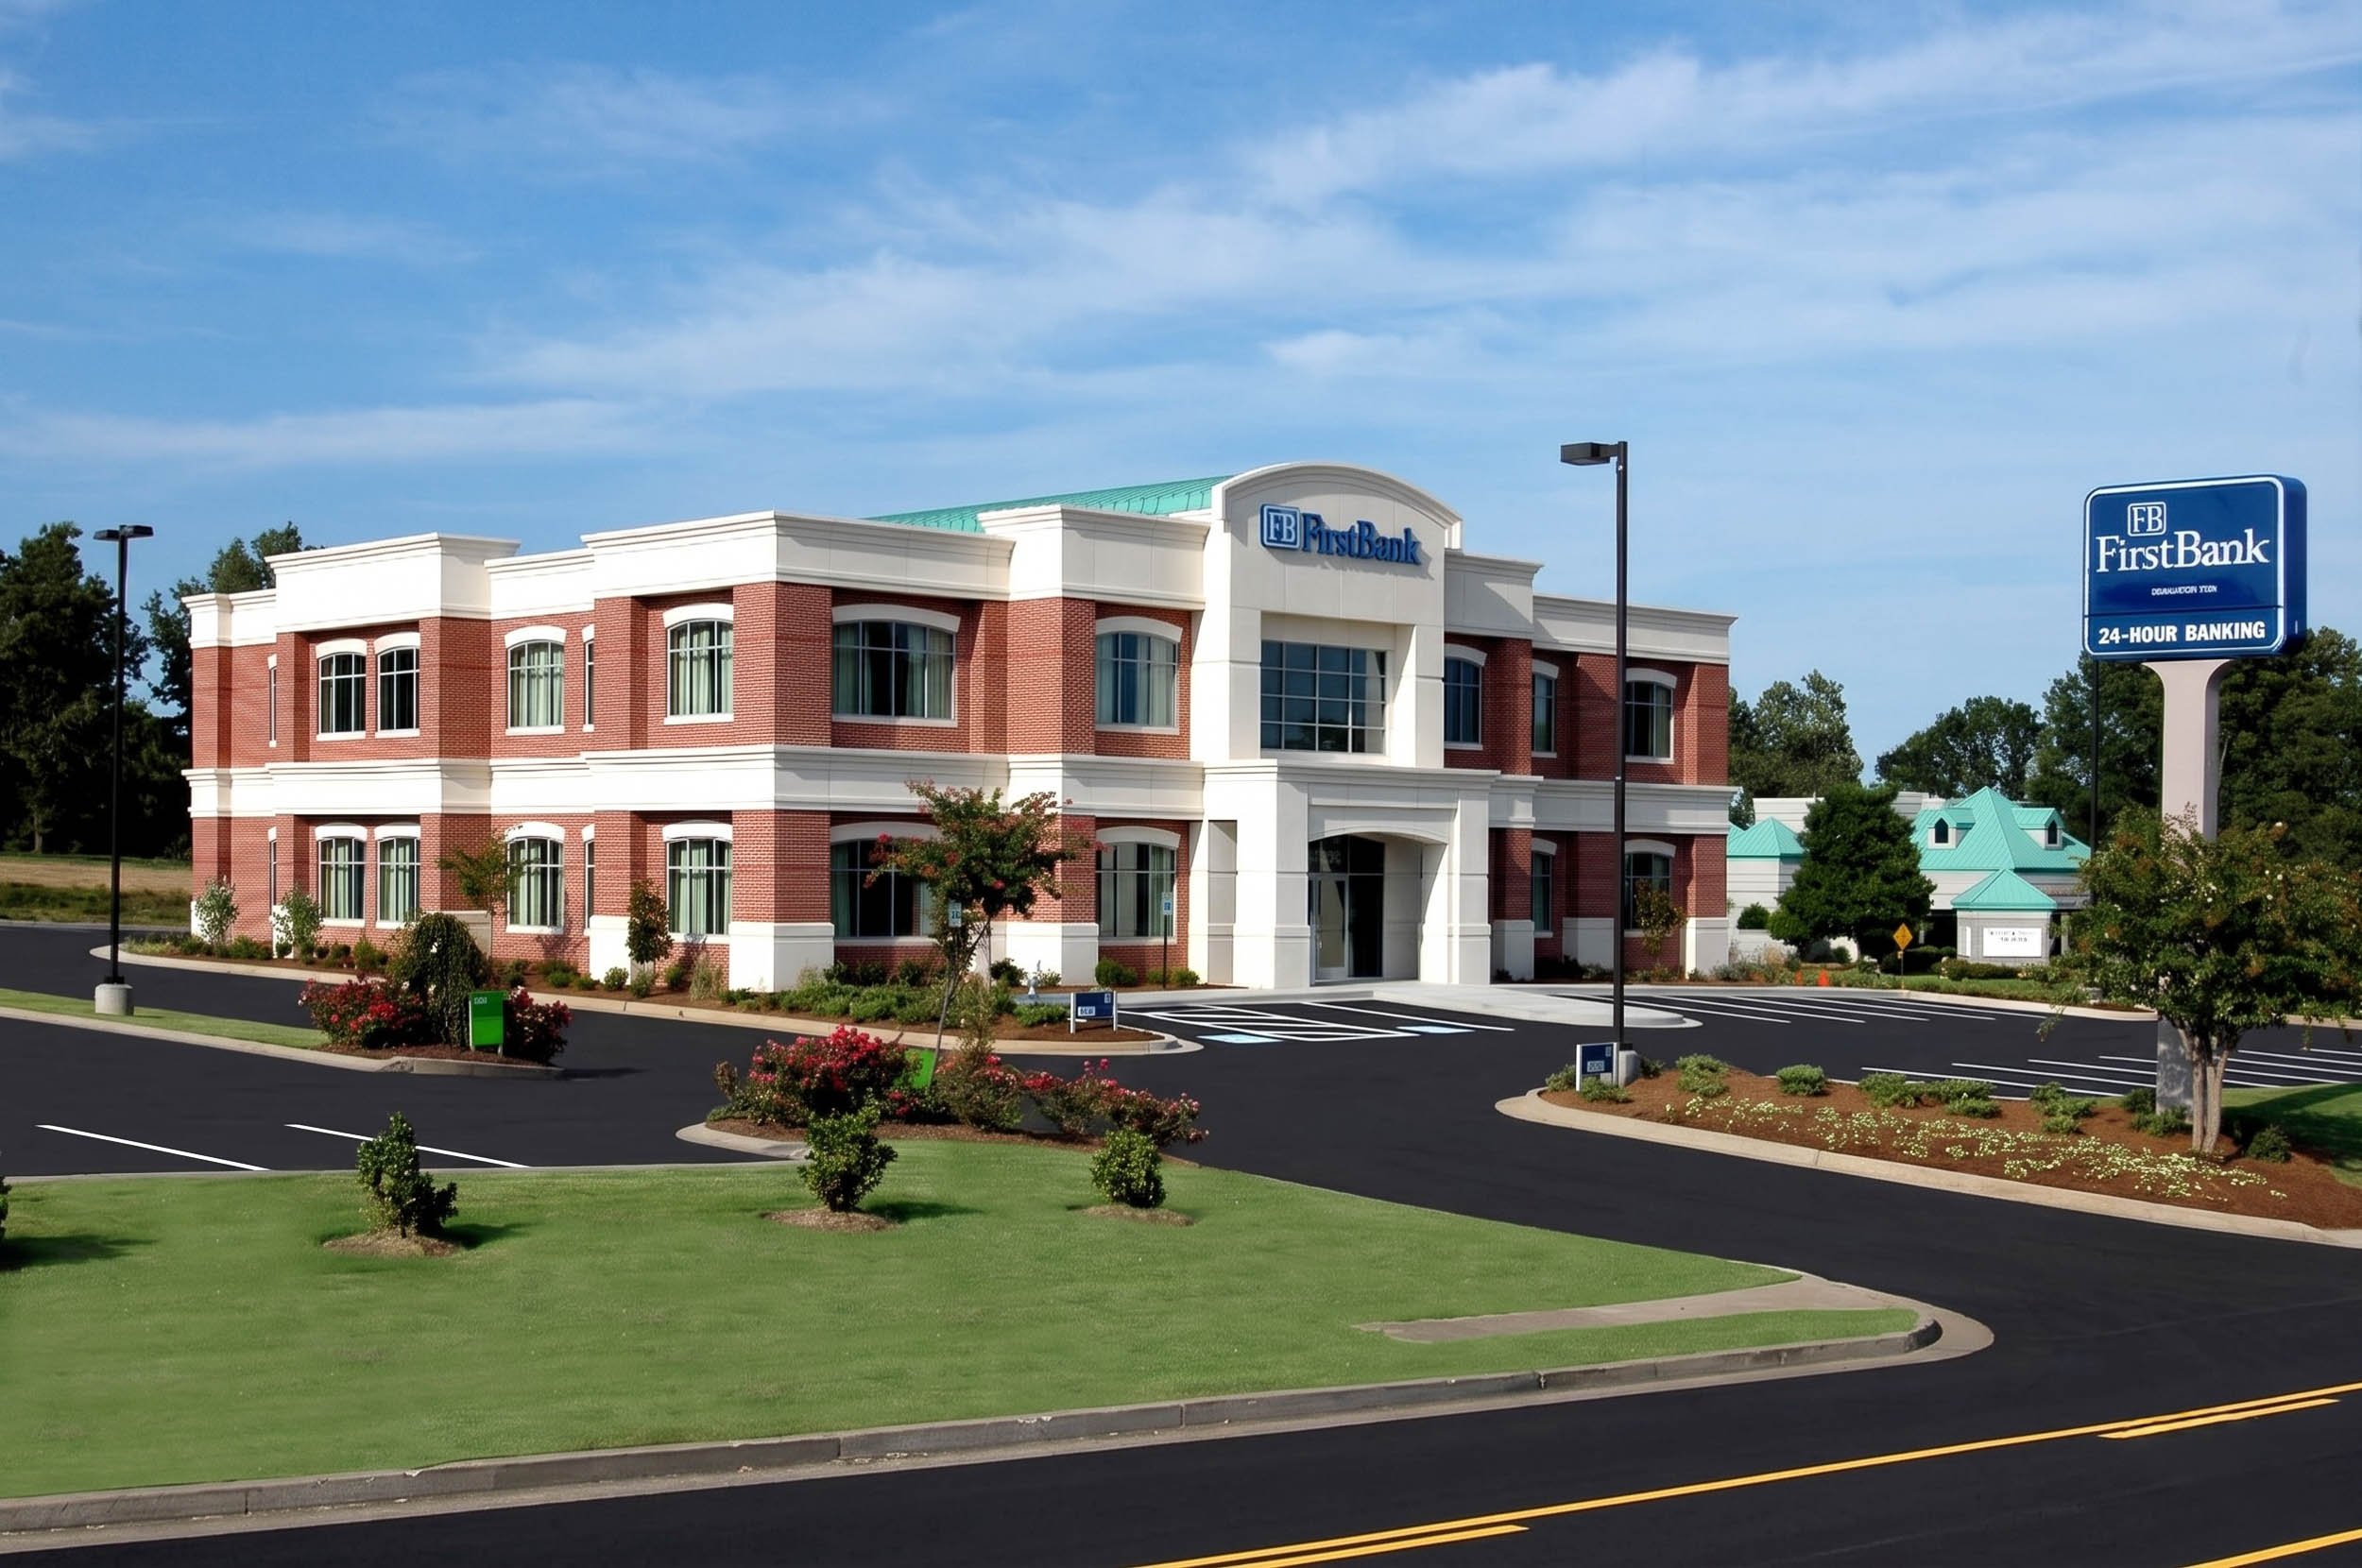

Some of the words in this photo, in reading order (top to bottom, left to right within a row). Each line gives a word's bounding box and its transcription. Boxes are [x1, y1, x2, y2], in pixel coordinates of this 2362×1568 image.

[2131, 505, 2164, 533] FB
[1268, 512, 1296, 542] FB
[1301, 512, 1422, 565] FirstBank
[2096, 528, 2270, 572] FirstBank
[2097, 625, 2178, 644] 24-HOUR
[2184, 621, 2267, 641] BANKING
